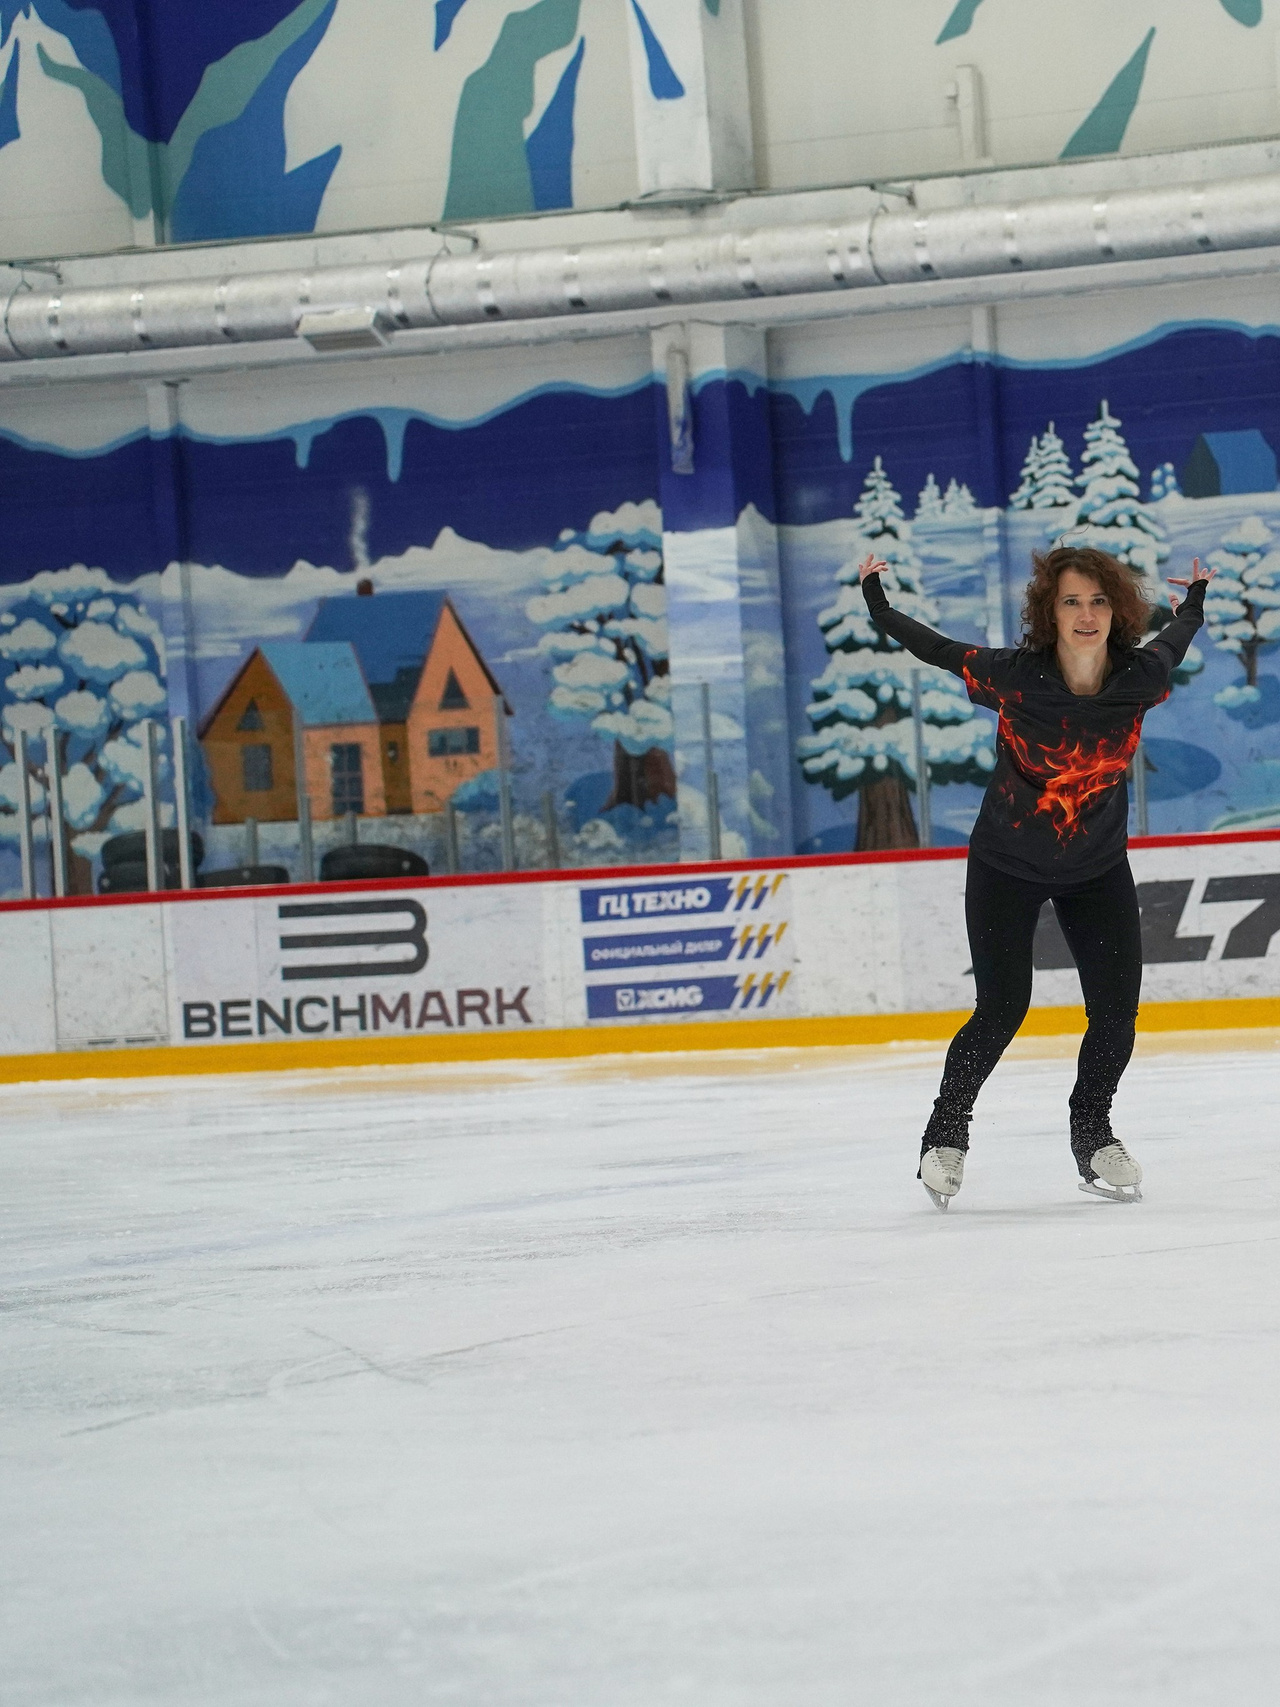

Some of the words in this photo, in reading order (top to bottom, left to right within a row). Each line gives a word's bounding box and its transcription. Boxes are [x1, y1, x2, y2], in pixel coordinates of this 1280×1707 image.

[598, 893, 629, 918] ГЦ
[631, 886, 712, 914] ТЕХНО
[182, 986, 534, 1039] BENCHMARK
